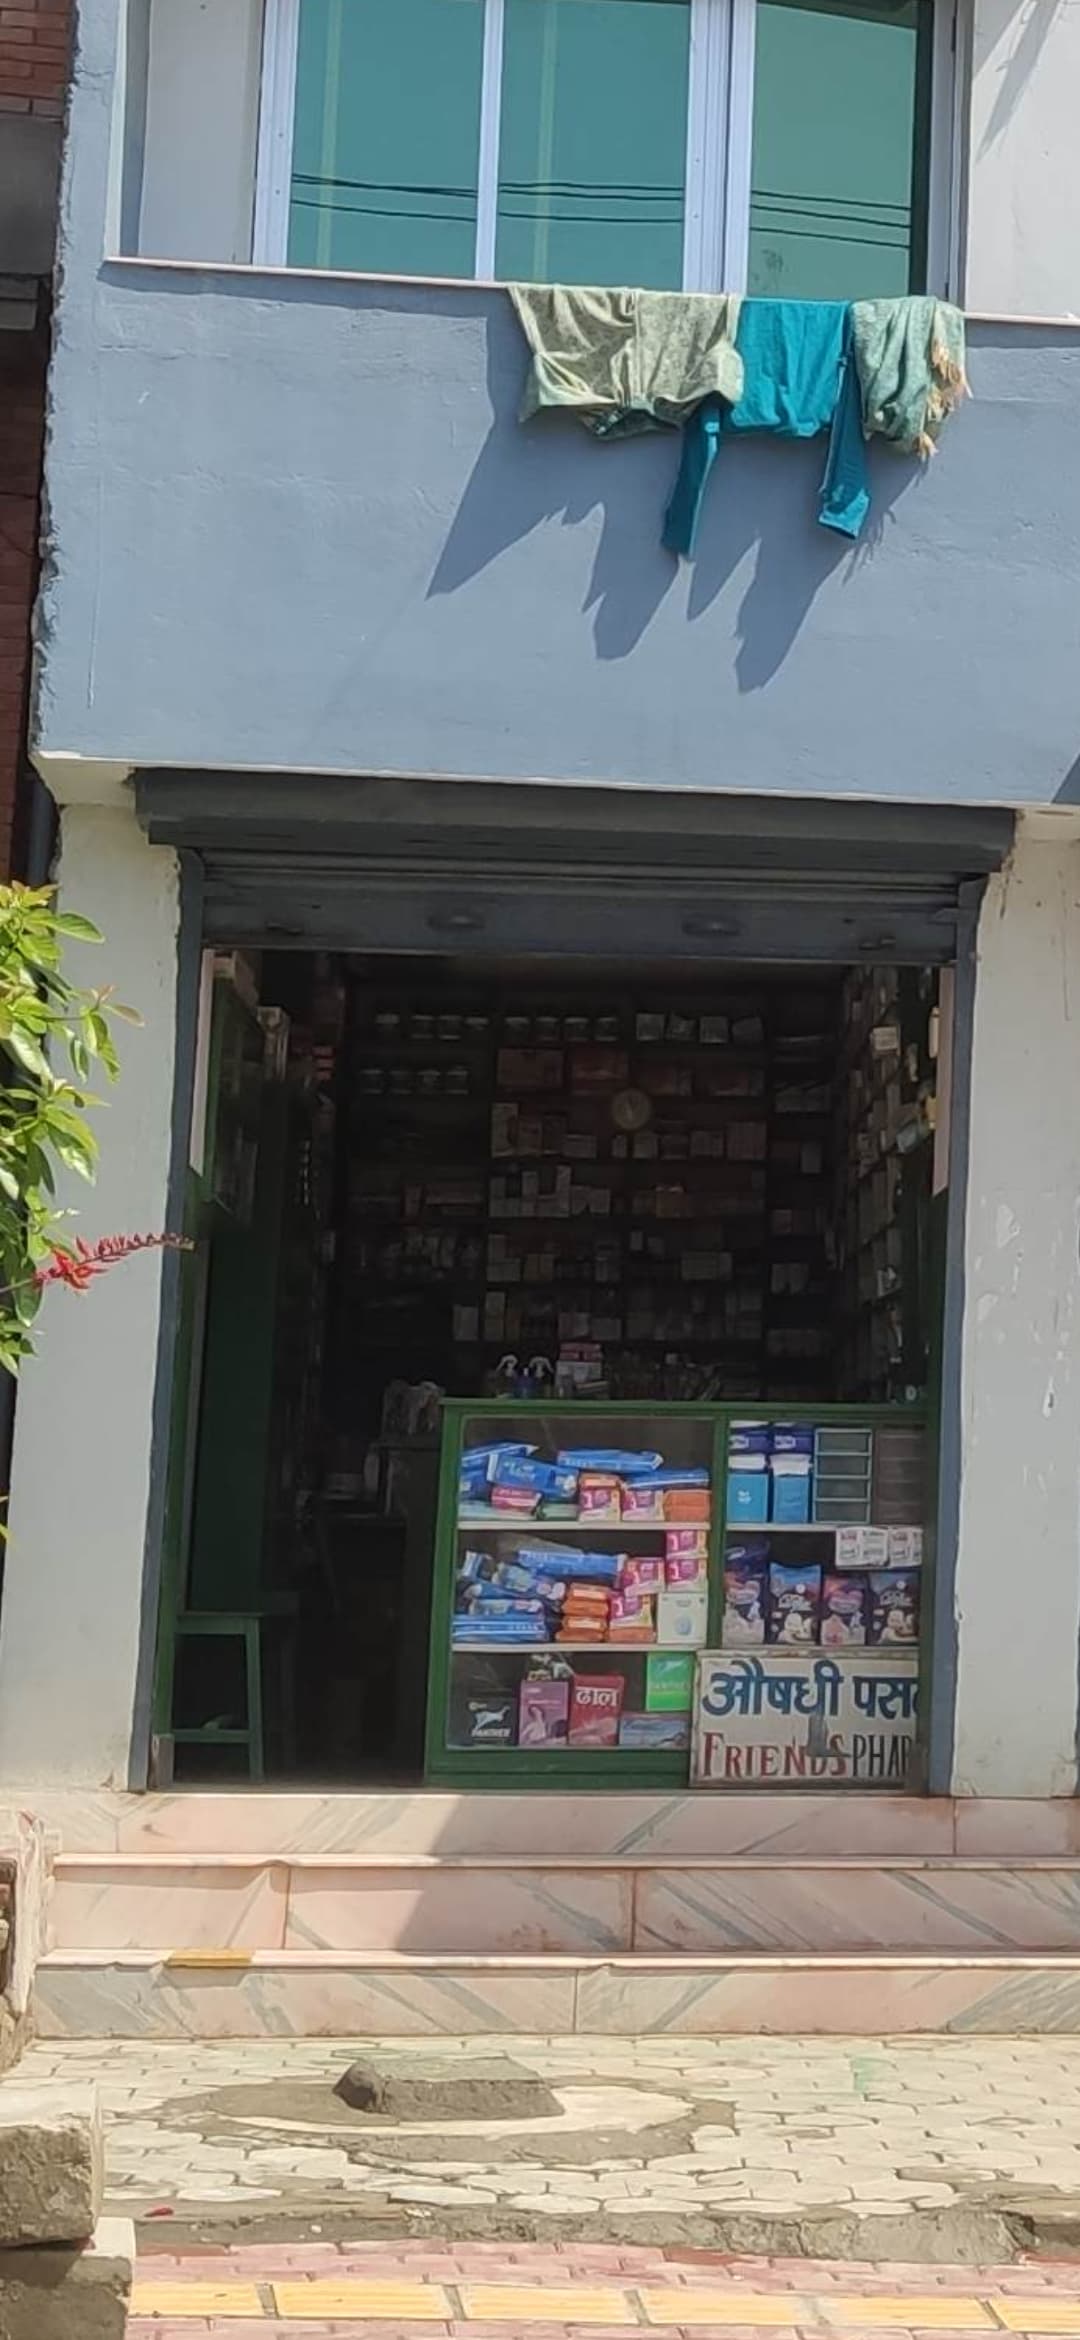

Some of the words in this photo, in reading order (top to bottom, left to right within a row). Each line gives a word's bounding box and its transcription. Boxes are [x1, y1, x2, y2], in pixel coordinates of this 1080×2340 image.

[576, 1686, 618, 1707] ढाल
[702, 1656, 845, 1717] औषधी
[852, 1675, 919, 1719] पस
